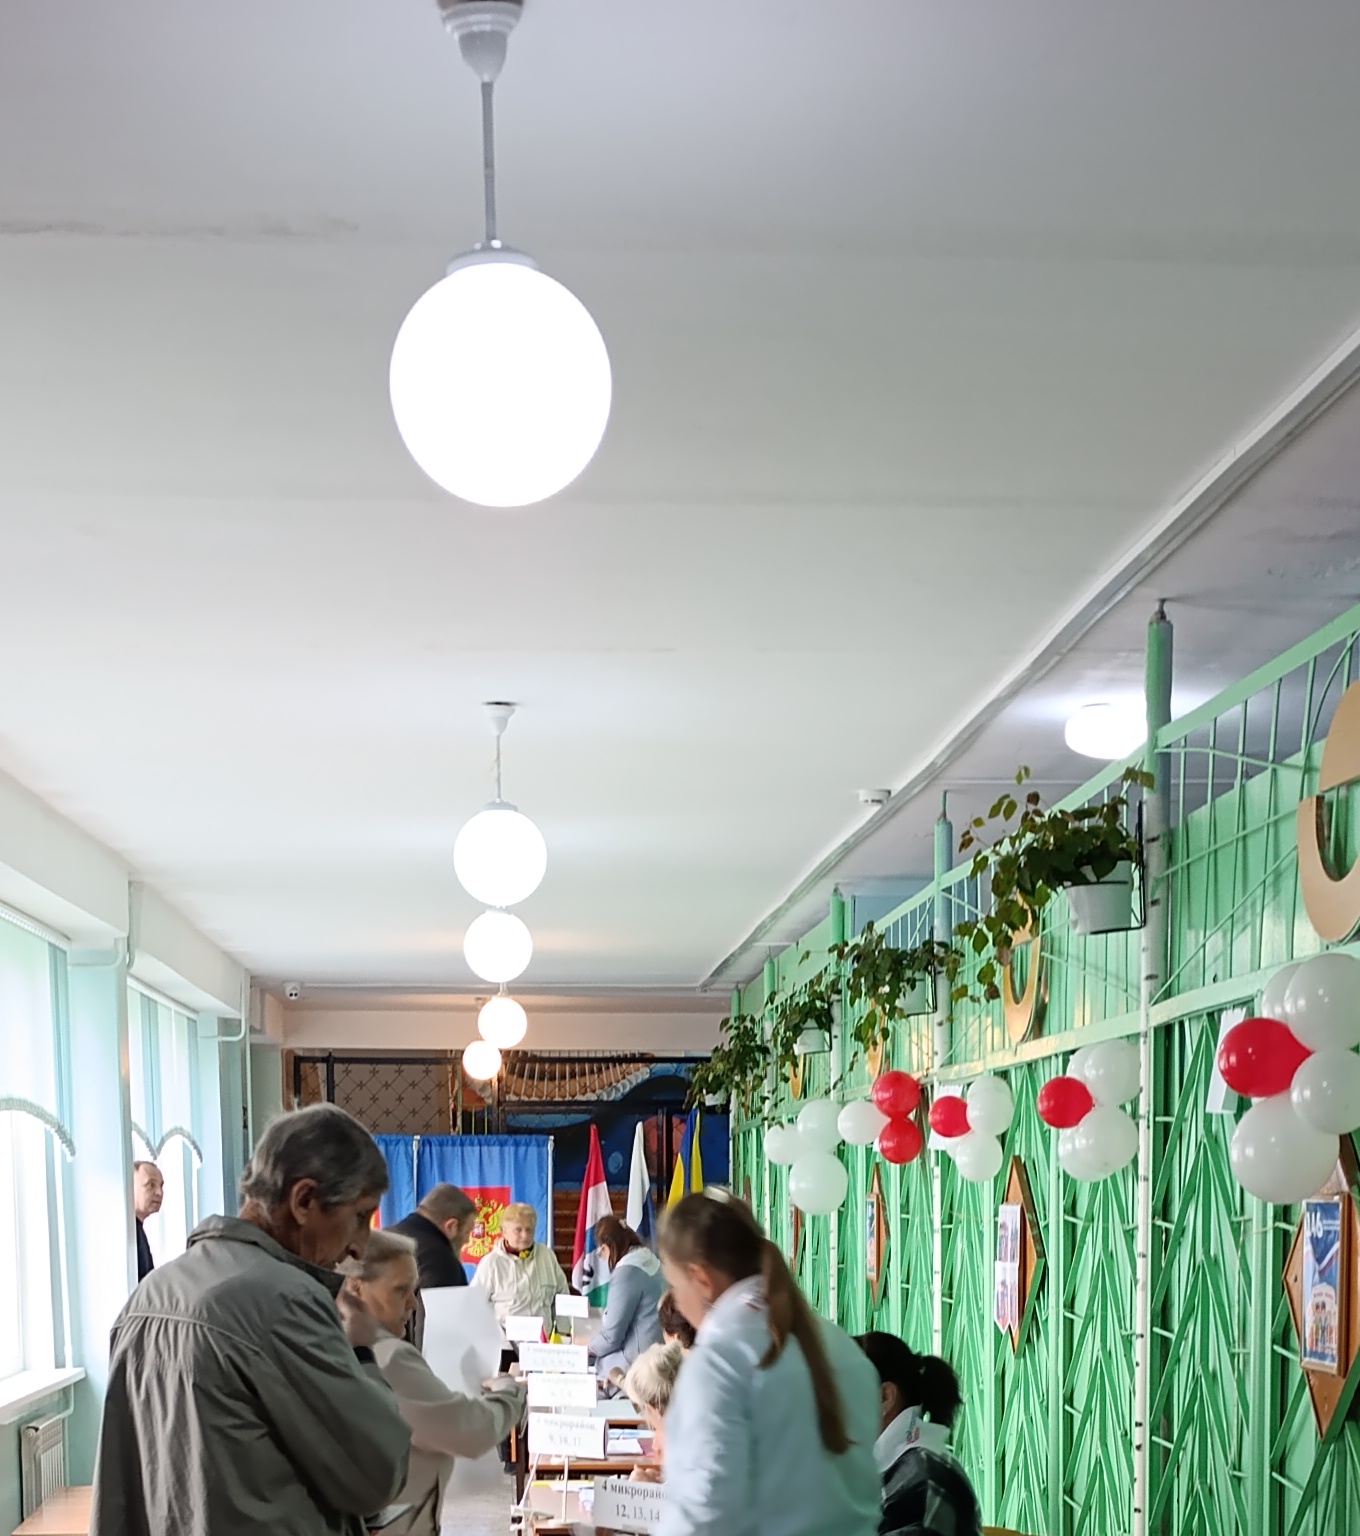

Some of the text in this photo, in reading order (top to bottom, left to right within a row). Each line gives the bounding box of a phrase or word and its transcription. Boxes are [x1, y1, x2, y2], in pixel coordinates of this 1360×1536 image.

[602, 1478, 667, 1500] 4 микрорайо
[616, 1504, 630, 1519] 12,
[634, 1506, 646, 1520] 13,
